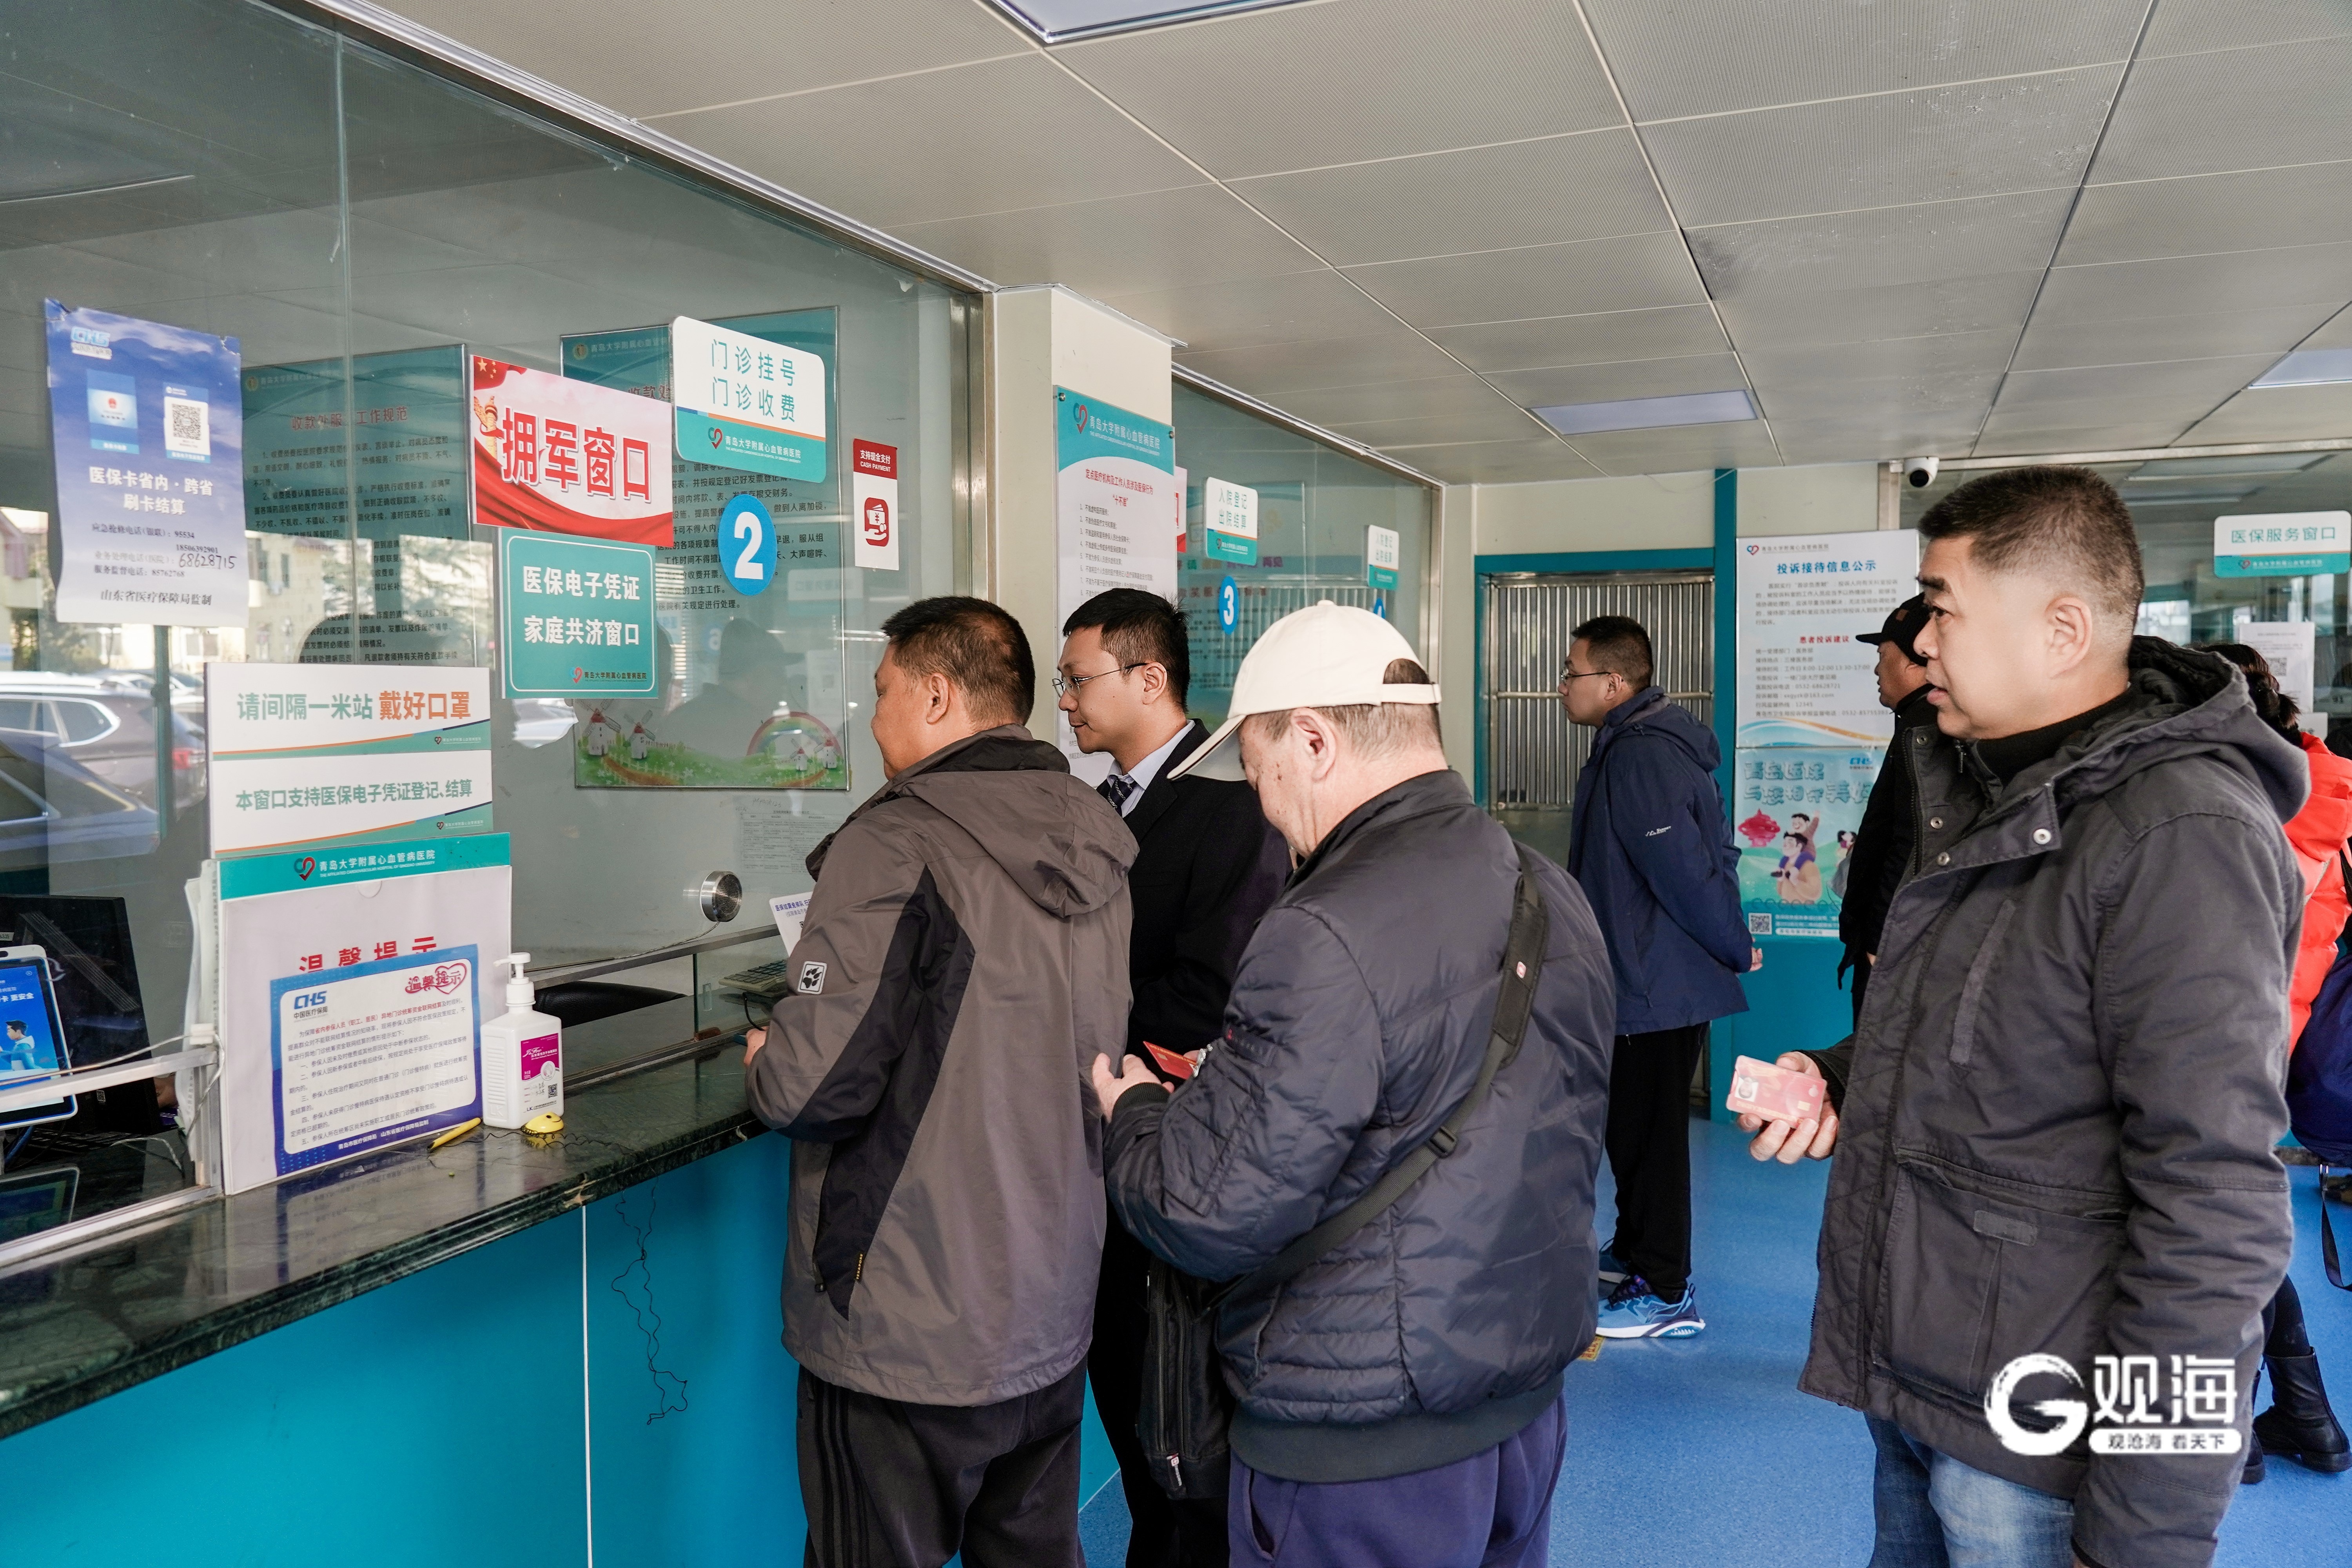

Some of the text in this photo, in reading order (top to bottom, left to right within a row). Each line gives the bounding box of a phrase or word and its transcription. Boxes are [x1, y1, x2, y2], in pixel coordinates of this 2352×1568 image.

[711, 339, 795, 387] 门诊挂号
[712, 376, 795, 423] 门诊收费
[292, 406, 408, 431] 收款处服工作规范
[502, 405, 652, 503] 拥军窗口
[725, 436, 801, 459] 青岛大学附属心血管病医院
[860, 449, 891, 465] 支持现金支付
[872, 463, 891, 472] PAYMENT
[123, 493, 186, 515] 刷卡结算
[734, 511, 764, 580] 2
[2231, 526, 2336, 543] 医保服务窗口
[179, 553, 237, 570] 68628715
[1777, 560, 1877, 575] 投诉接待信息公示
[523, 566, 640, 600] 医保电子凭证
[101, 589, 212, 606] 山东省医疗保障局监制
[1223, 585, 1234, 626] 3
[524, 615, 640, 647] 家庭共济窗口
[237, 690, 471, 720] 请间隔一米站 戴好口罩
[236, 778, 472, 811] 本窗口支持医保电子凭证登记、结算
[319, 849, 436, 872] 青岛大学附属心血管病医院
[294, 991, 327, 1010] CHS
